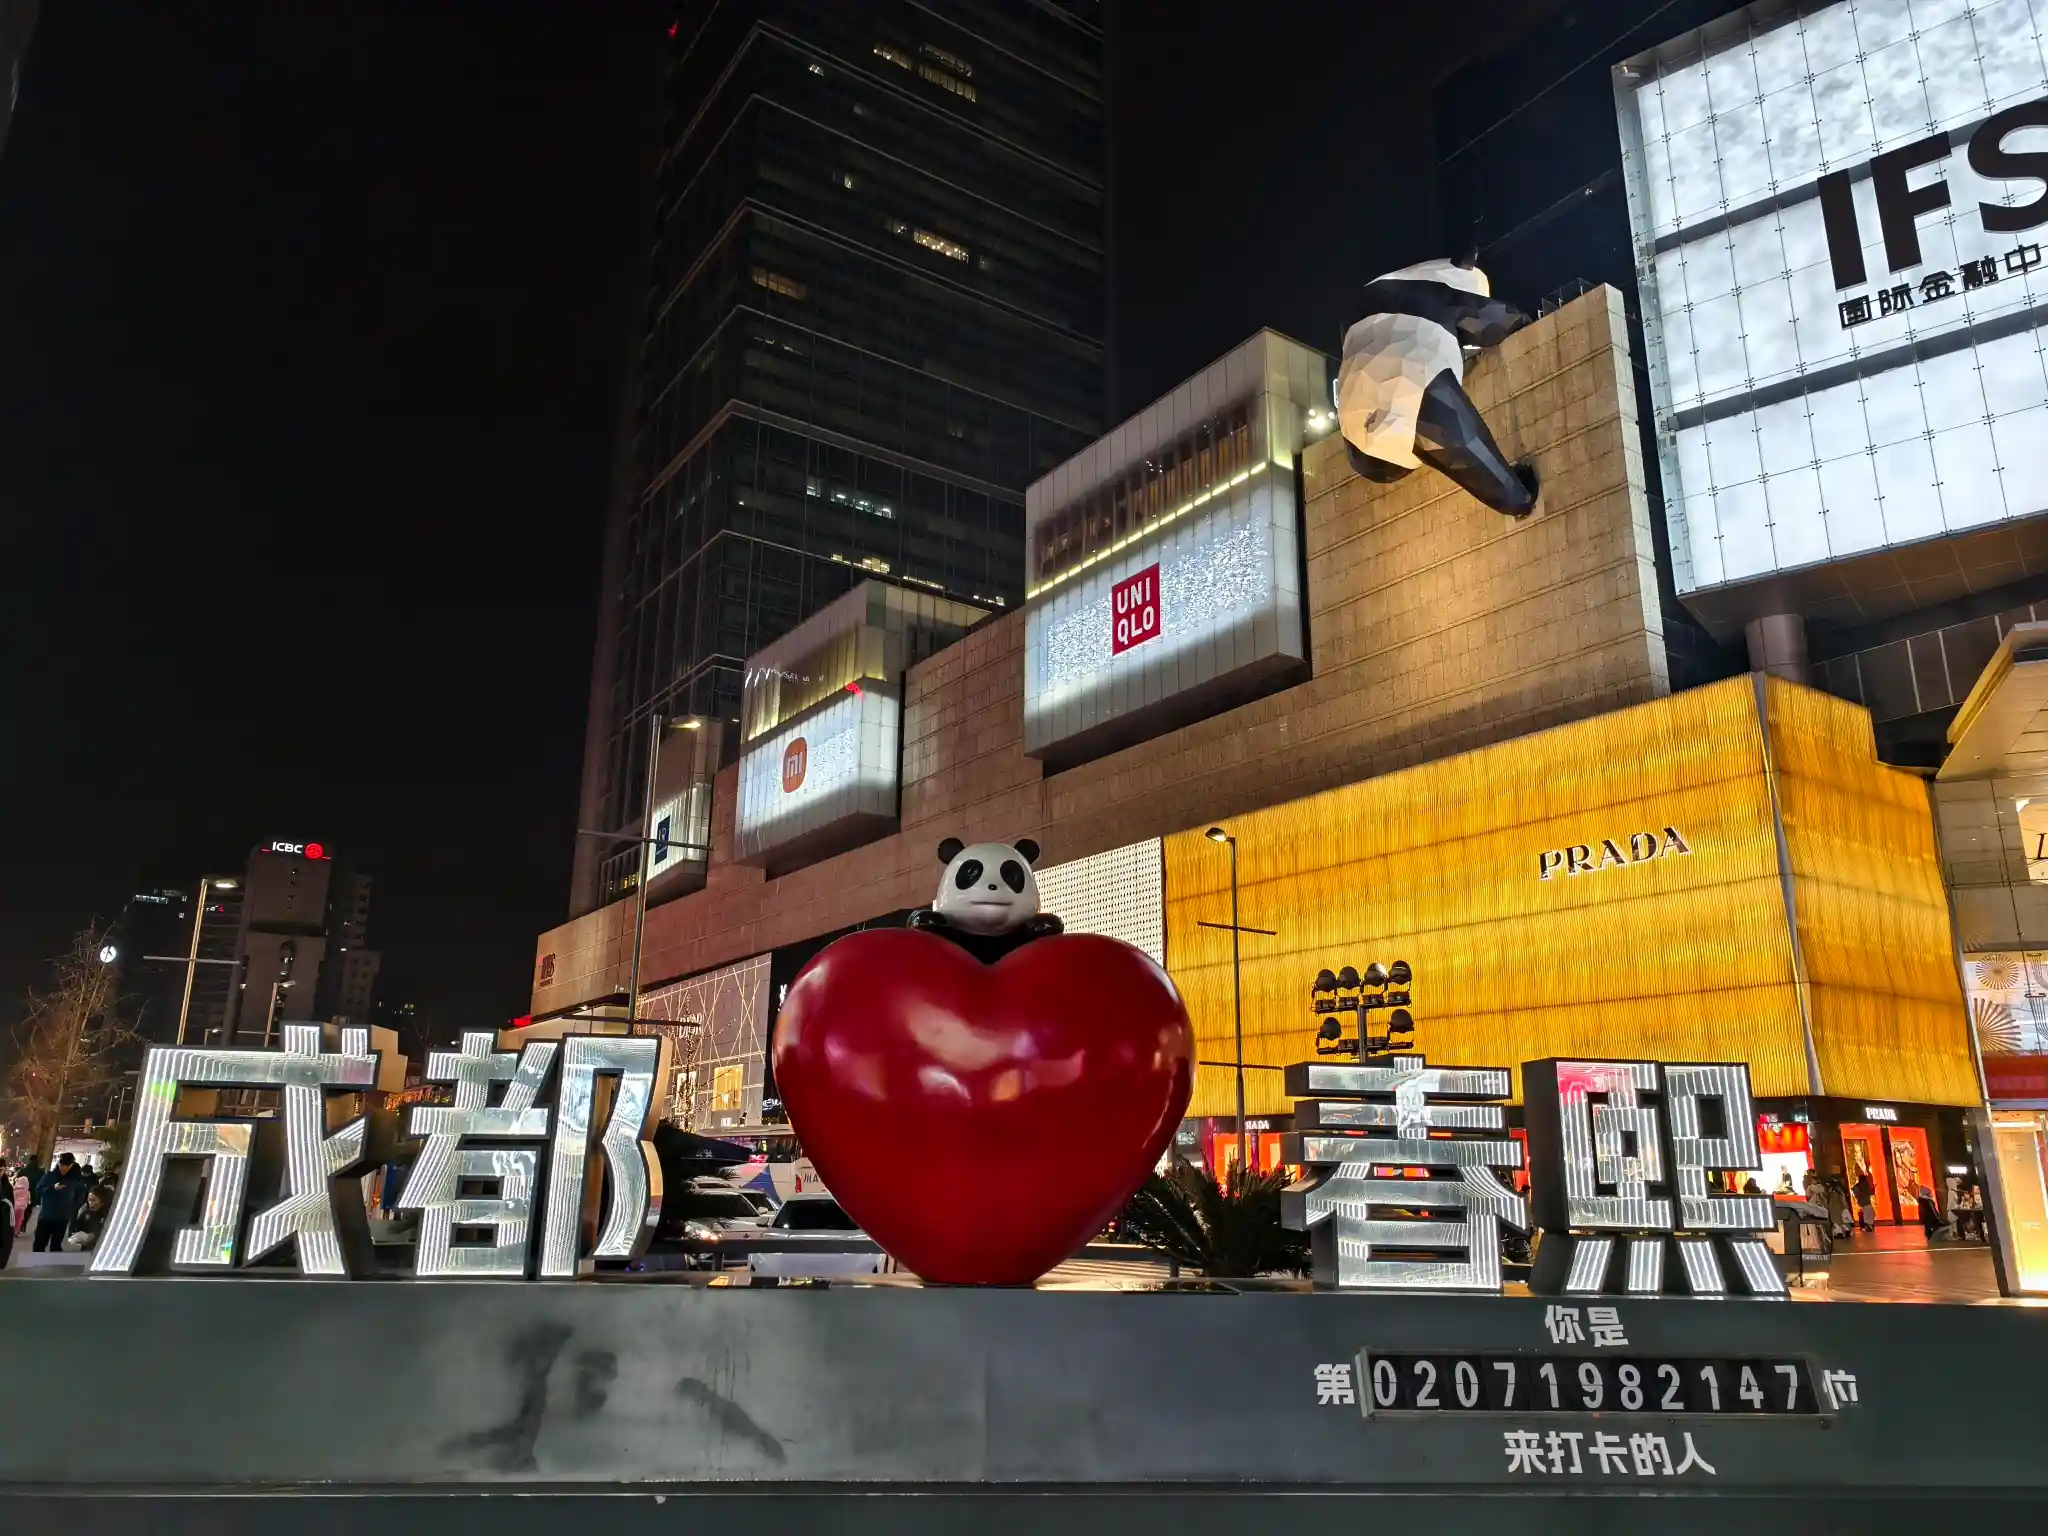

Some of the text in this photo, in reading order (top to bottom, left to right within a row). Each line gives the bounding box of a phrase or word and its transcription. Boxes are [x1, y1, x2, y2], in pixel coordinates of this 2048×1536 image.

[1817, 95, 2048, 291] IFS
[1838, 243, 2042, 330] 国际金融中
[1117, 577, 1150, 614] UNI
[1117, 606, 1155, 645] QLO
[271, 841, 303, 854] ICBC
[1538, 826, 1692, 880] PRADA
[1865, 1107, 1898, 1121] PRADA
[88, 1022, 1789, 1298] 成都 春熙
[1544, 1304, 1629, 1348] 你是
[1313, 1358, 1859, 1411] 第 02071982147 位
[1503, 1429, 1717, 1476] 来打卡的人
